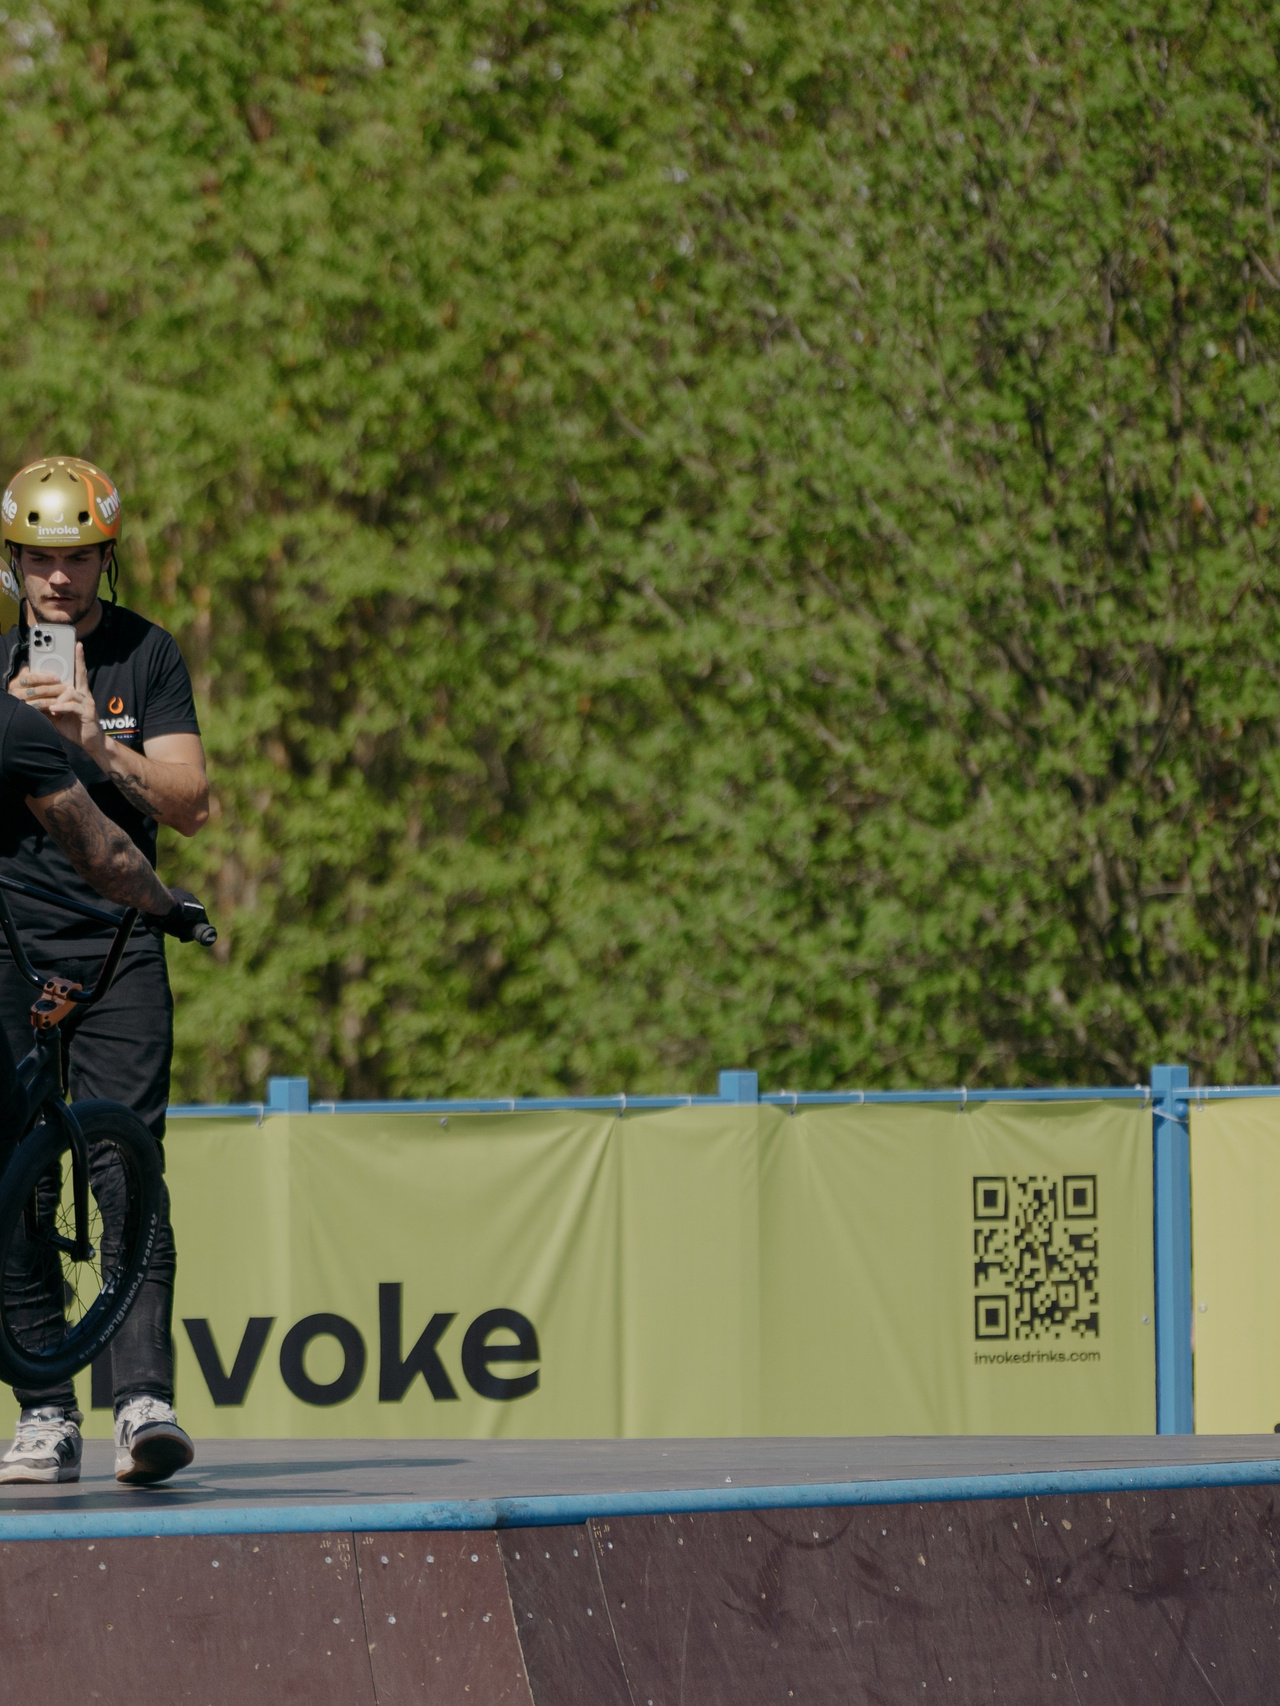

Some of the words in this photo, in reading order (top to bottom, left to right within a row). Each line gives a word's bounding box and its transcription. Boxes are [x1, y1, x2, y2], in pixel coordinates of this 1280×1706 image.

[38, 525, 80, 535] invoke
[91, 1281, 541, 1408] voke
[974, 1350, 1101, 1364] invokedrinks.com
